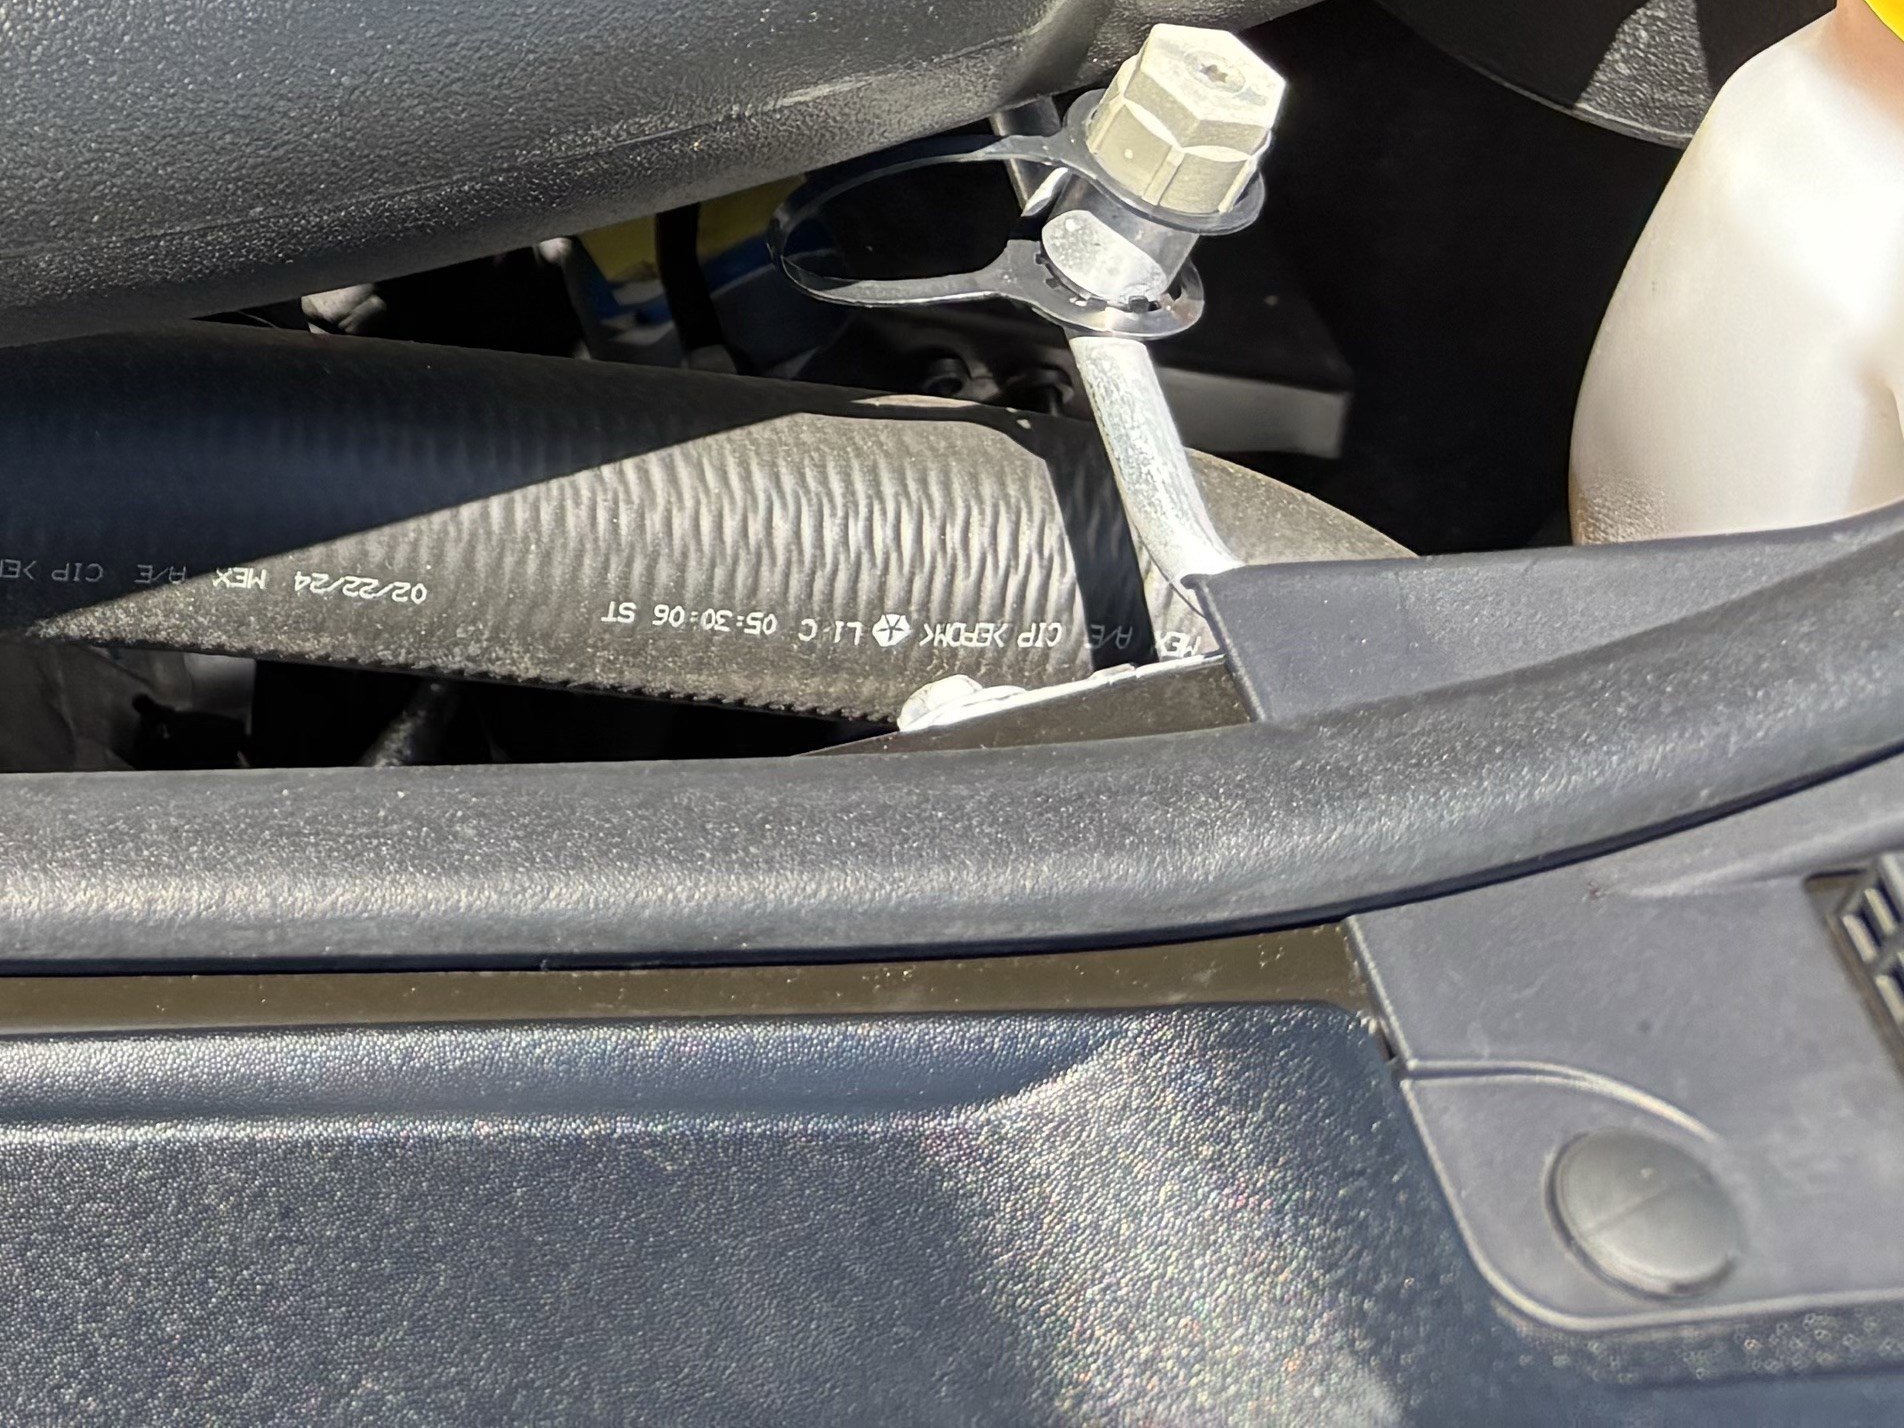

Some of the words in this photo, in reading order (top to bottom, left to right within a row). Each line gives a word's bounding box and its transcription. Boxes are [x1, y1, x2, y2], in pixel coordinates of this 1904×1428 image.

[50, 562, 104, 582] CIP
[134, 563, 188, 585] A/E
[211, 566, 268, 591] MEX
[293, 570, 428, 605] 02/22/24
[600, 600, 638, 624] ST
[651, 604, 779, 636] 05:30:06
[1017, 621, 1064, 649] CIP
